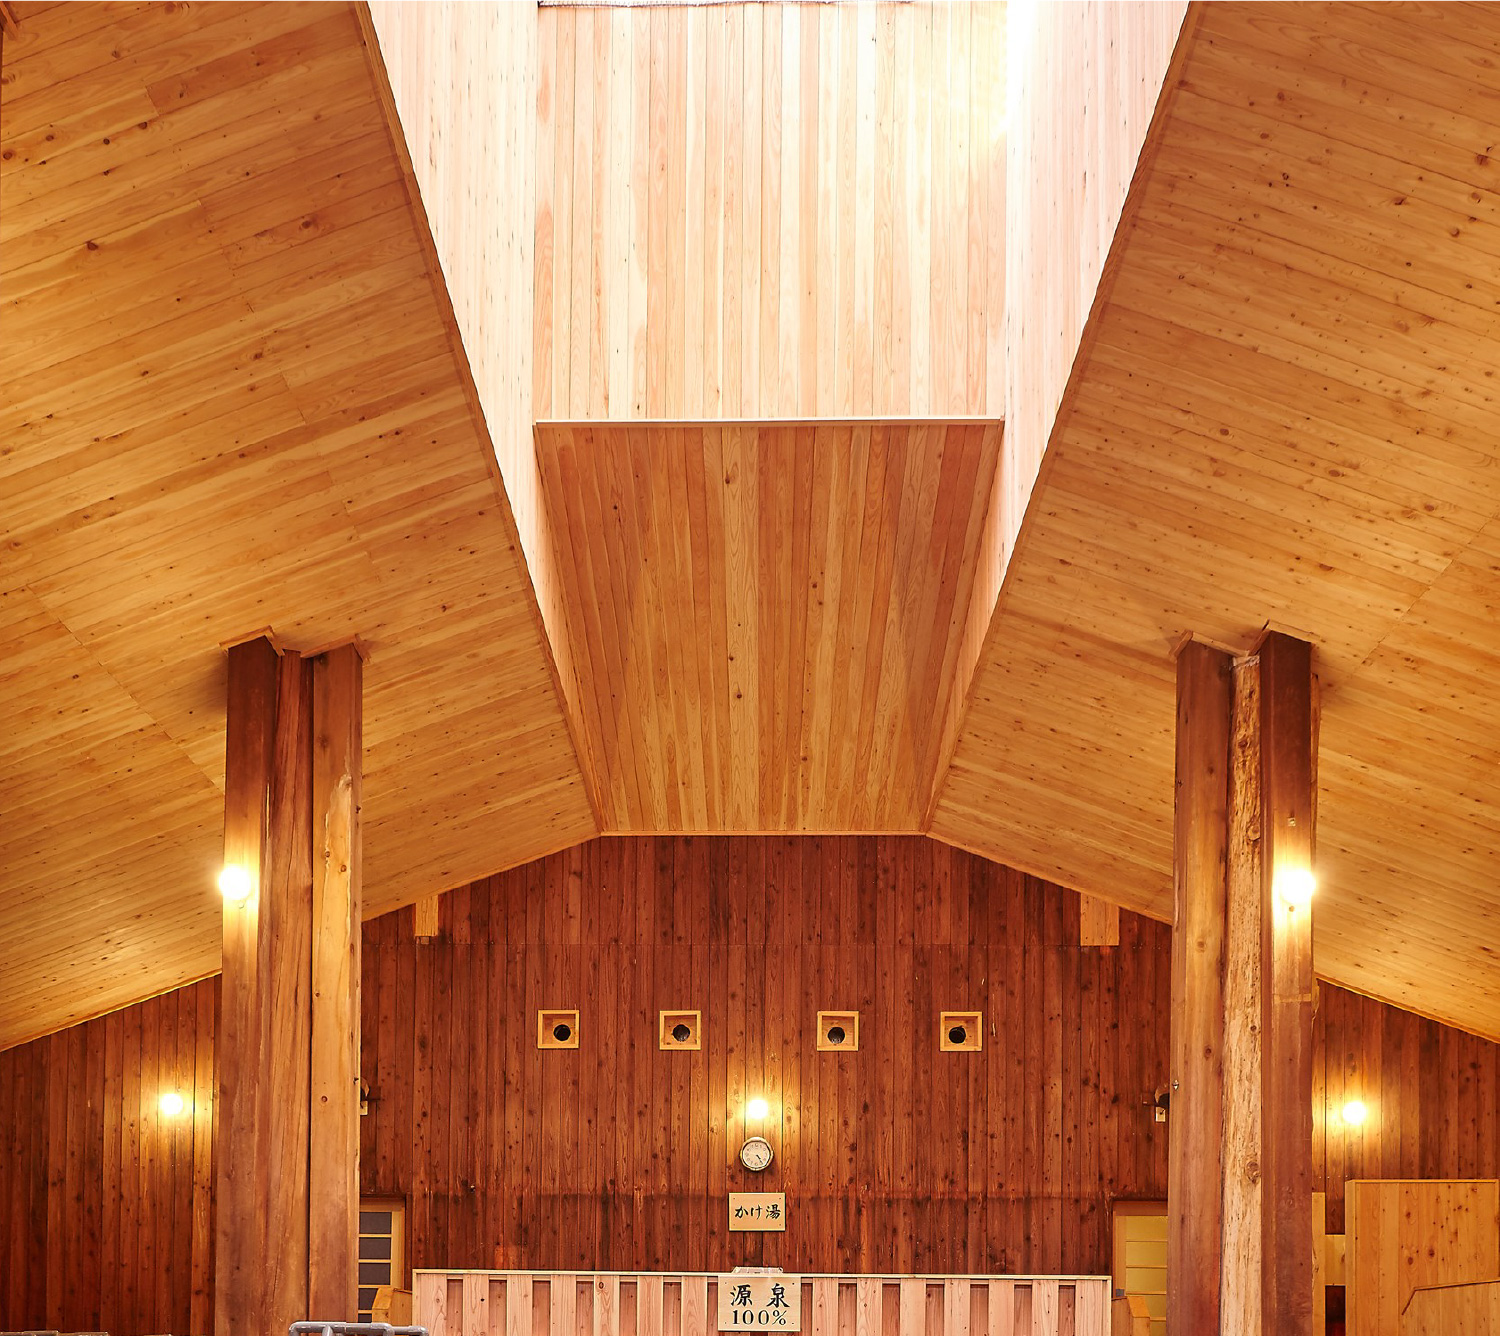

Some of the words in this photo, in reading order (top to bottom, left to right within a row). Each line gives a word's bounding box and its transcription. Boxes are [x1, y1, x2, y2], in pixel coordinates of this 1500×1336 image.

[735, 1204, 781, 1219] かけ湯
[733, 1310, 787, 1325] 100%
